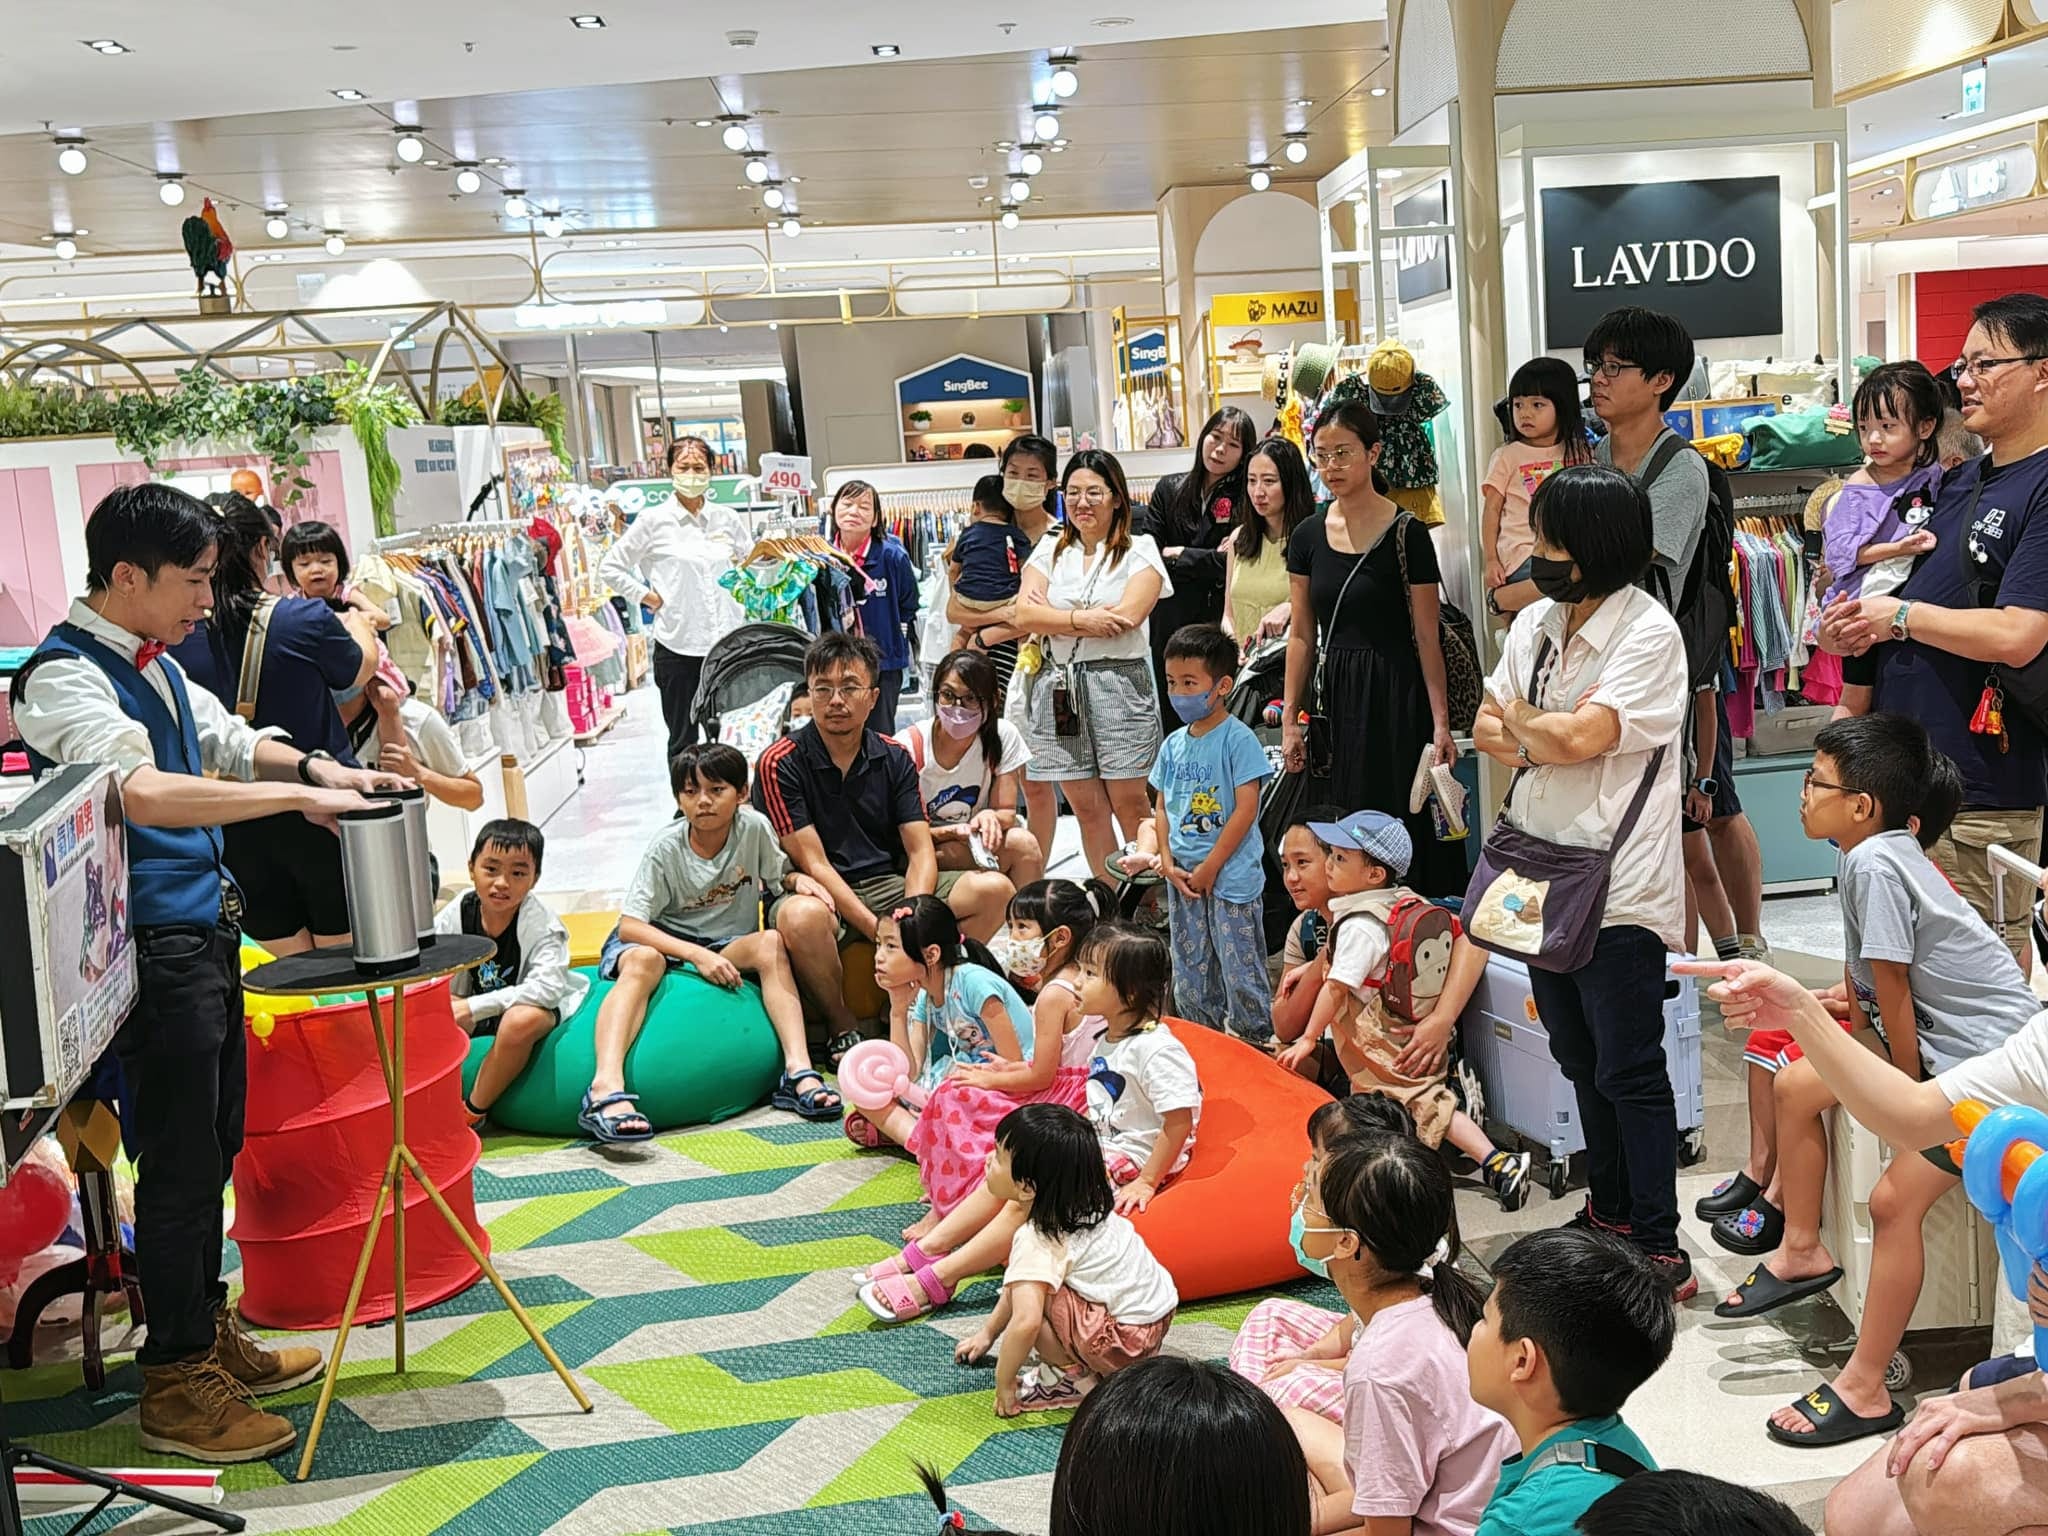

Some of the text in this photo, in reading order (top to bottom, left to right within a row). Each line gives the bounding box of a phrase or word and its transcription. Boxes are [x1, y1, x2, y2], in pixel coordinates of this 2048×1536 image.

[1572, 237, 1756, 288] LAVIDO
[1272, 301, 1318, 319] MAZU
[1131, 345, 1166, 361] SingB
[943, 379, 989, 394] SingBee
[769, 470, 801, 488] 490
